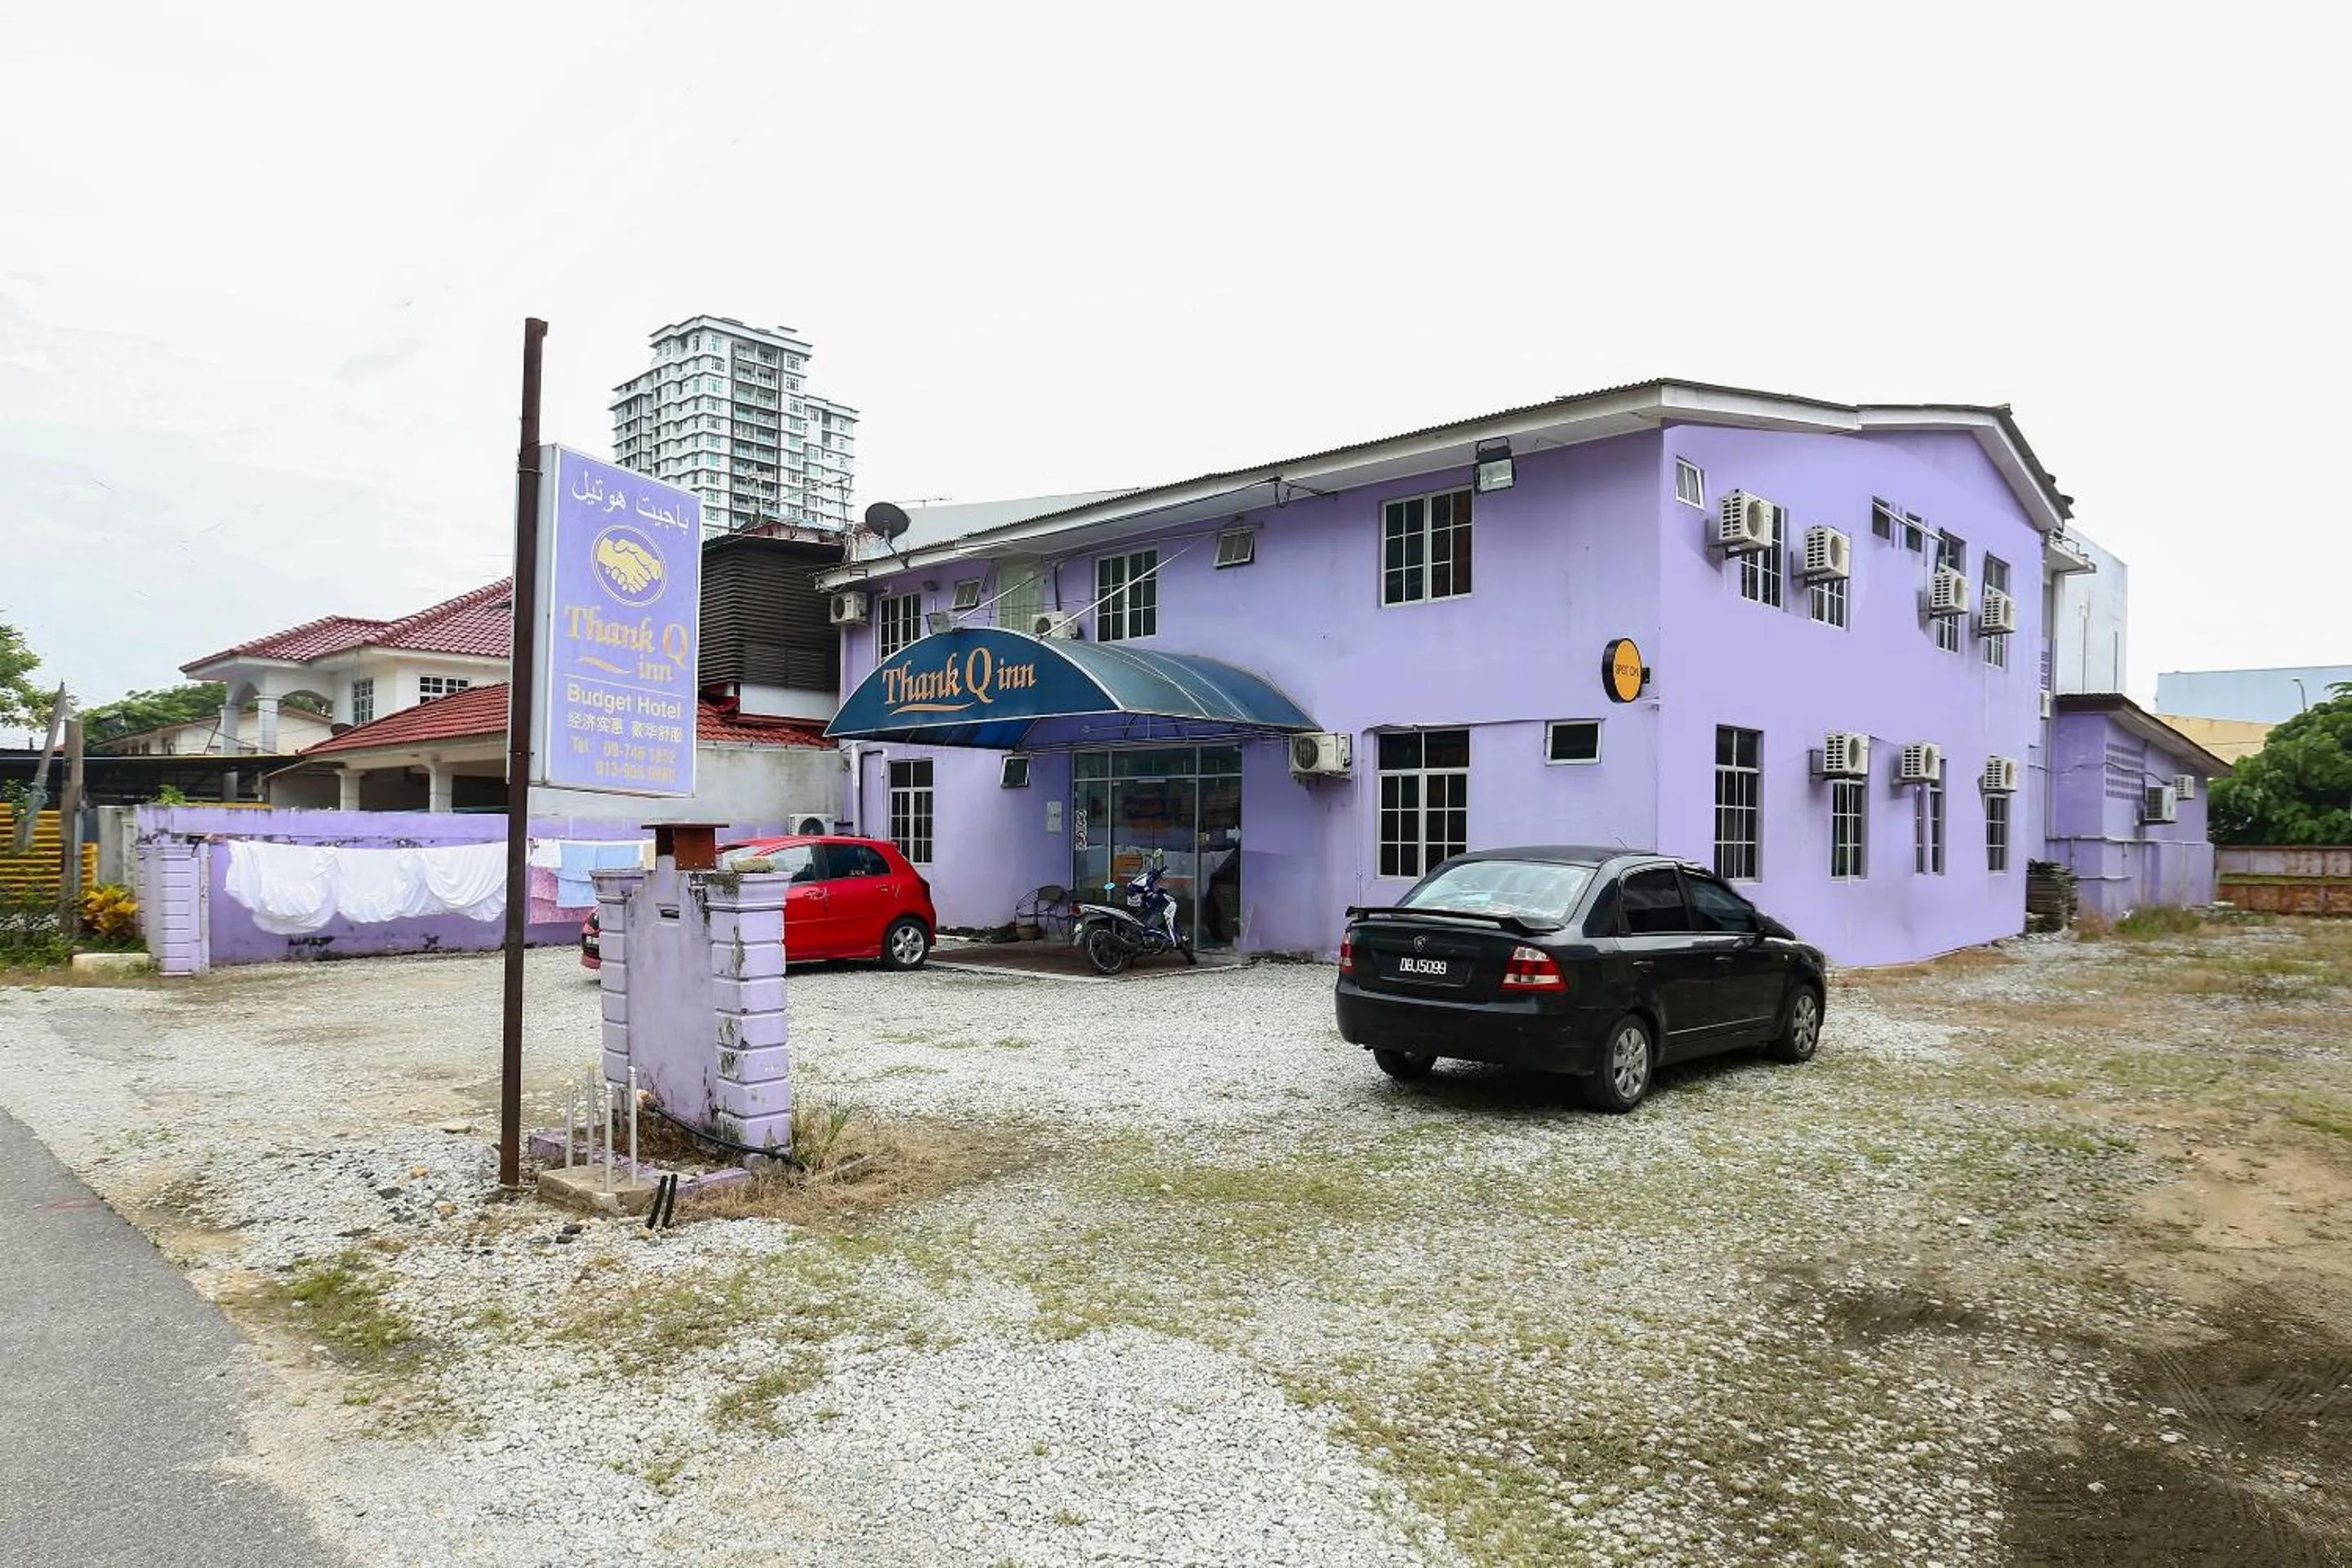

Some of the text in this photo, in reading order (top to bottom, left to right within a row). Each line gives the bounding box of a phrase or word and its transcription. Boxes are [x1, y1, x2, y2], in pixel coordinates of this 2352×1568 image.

[564, 604, 689, 670] Thank Q
[639, 654, 674, 682] inn
[882, 647, 1036, 705] Thank Q inn
[568, 683, 681, 719] Budget Hotel
